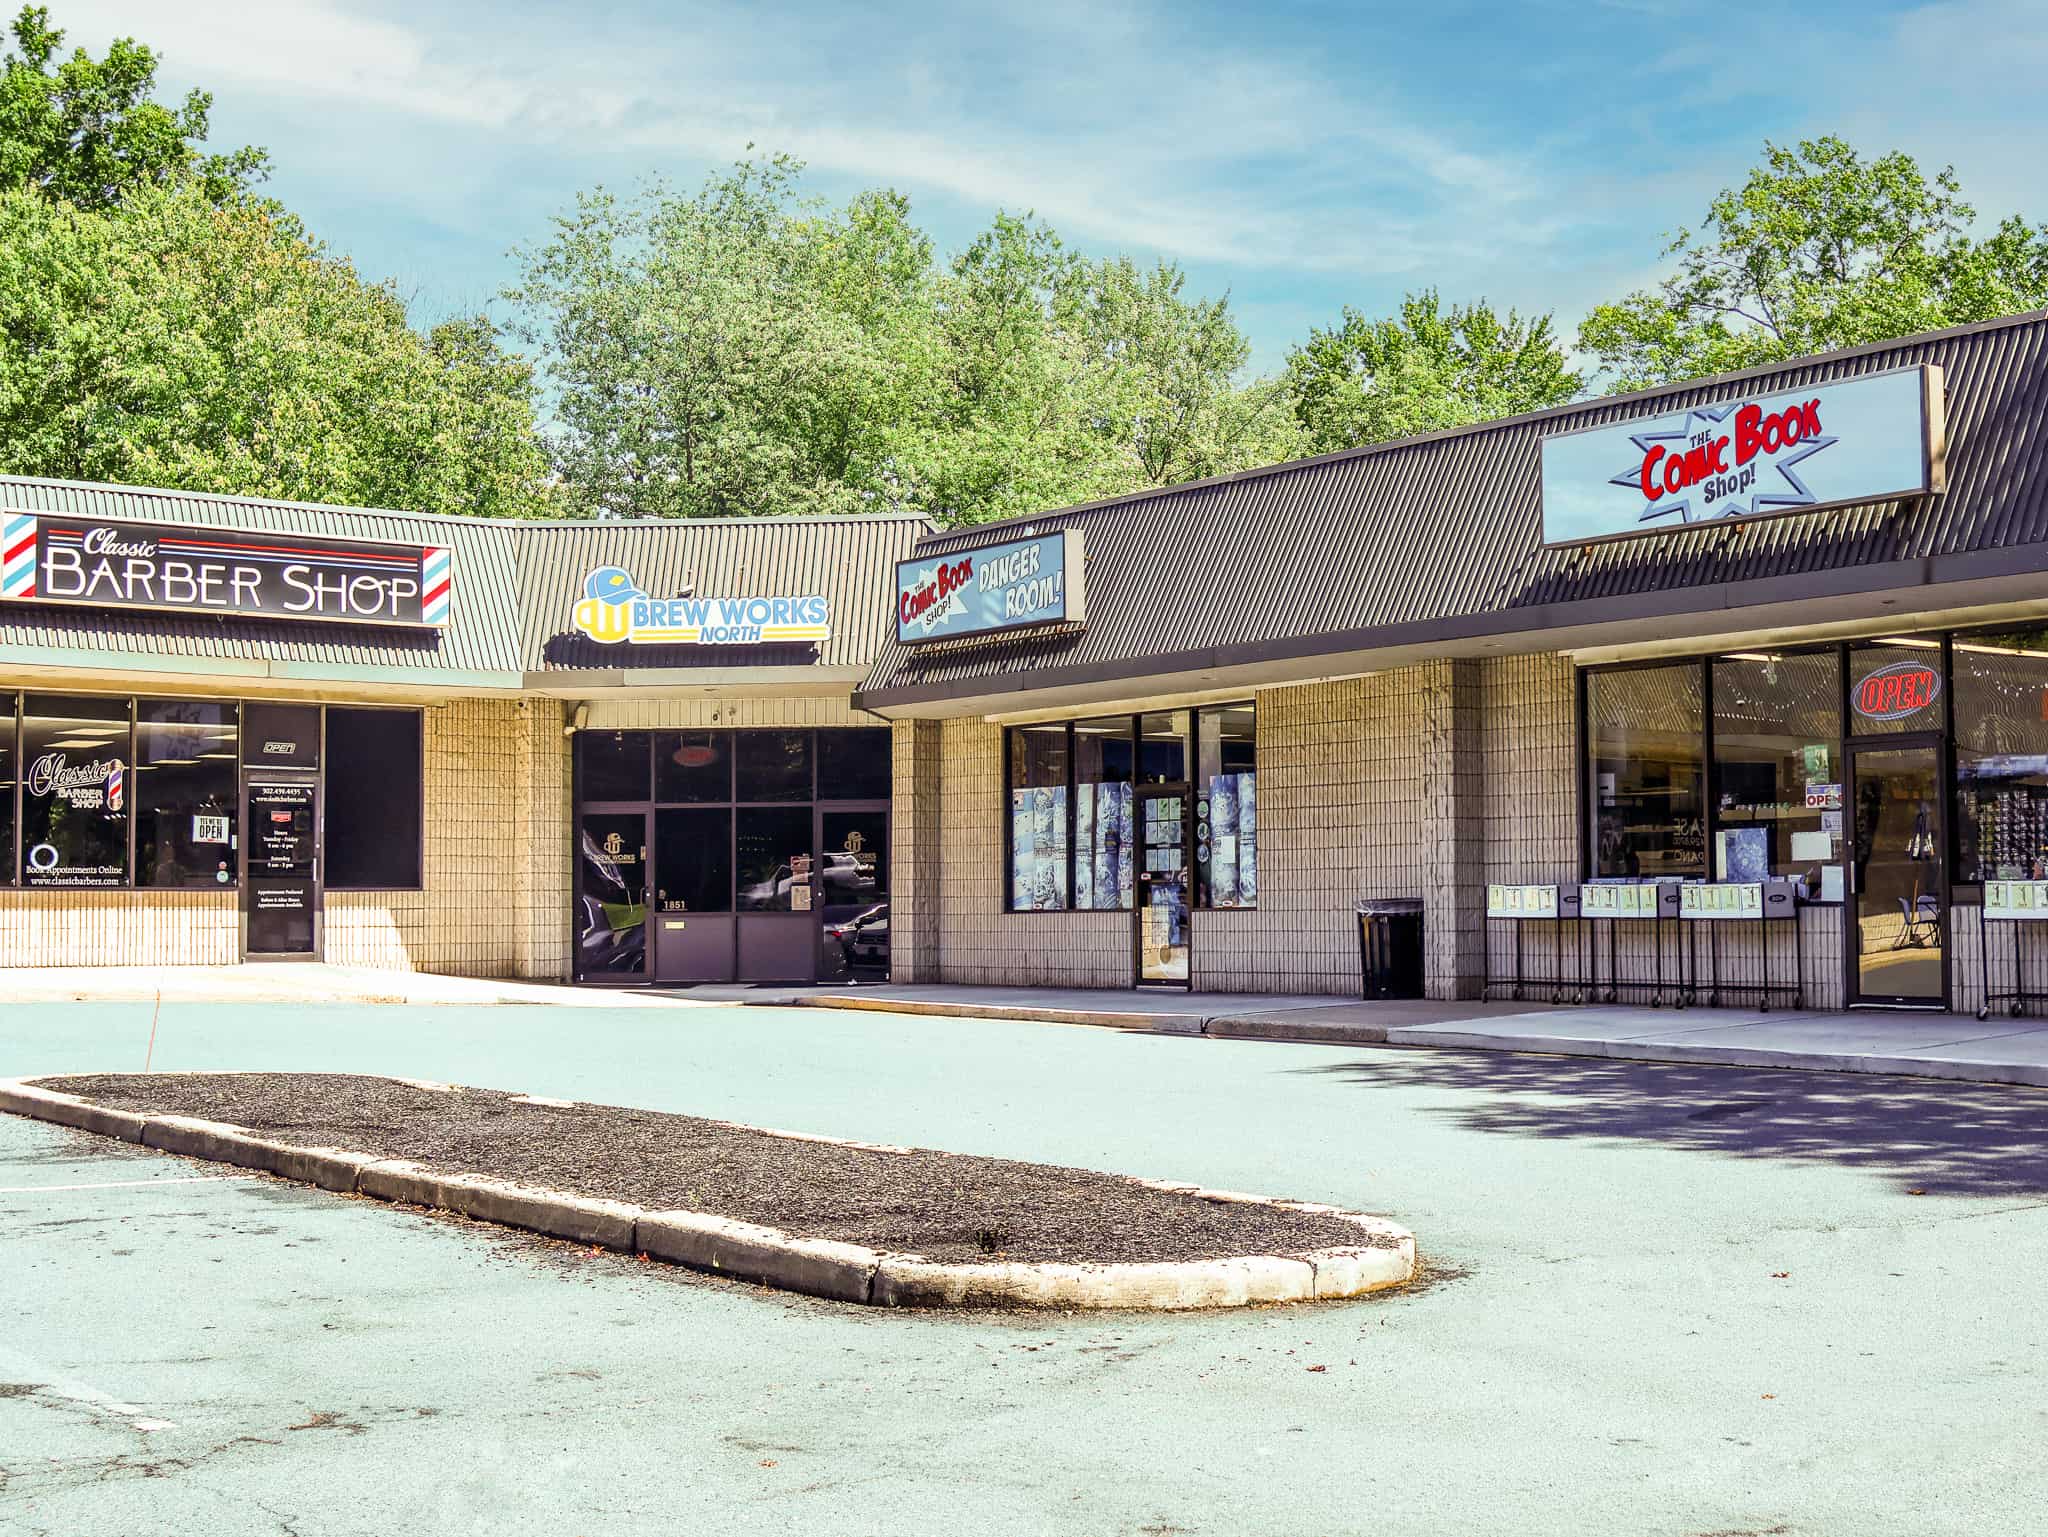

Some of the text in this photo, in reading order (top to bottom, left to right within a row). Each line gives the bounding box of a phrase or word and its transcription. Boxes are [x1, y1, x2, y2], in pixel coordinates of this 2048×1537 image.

[1641, 398, 1822, 501] COMIC BOOK
[1690, 429, 1711, 448] THE
[1704, 463, 1756, 503] Shop!
[83, 527, 156, 558] Classic
[40, 547, 417, 616] BARBER SHOP
[979, 543, 1041, 593] DANGER
[901, 556, 974, 625] COMIC BOOK
[915, 582, 925, 592] THE
[1005, 570, 1063, 620] ROOM!
[634, 597, 827, 627] BREW WORKS
[926, 595, 951, 626] SHOP!
[700, 625, 761, 642] NORTH
[1861, 671, 1933, 713] OPEN
[29, 753, 109, 796] Classic
[57, 788, 103, 798] BARBER
[72, 798, 103, 808] SHOP
[200, 825, 223, 839] OPEN
[31, 876, 119, 886] www.classicbarbers.com
[46, 865, 97, 876] Appointments
[98, 865, 123, 874] Online
[664, 900, 685, 909] 1851
